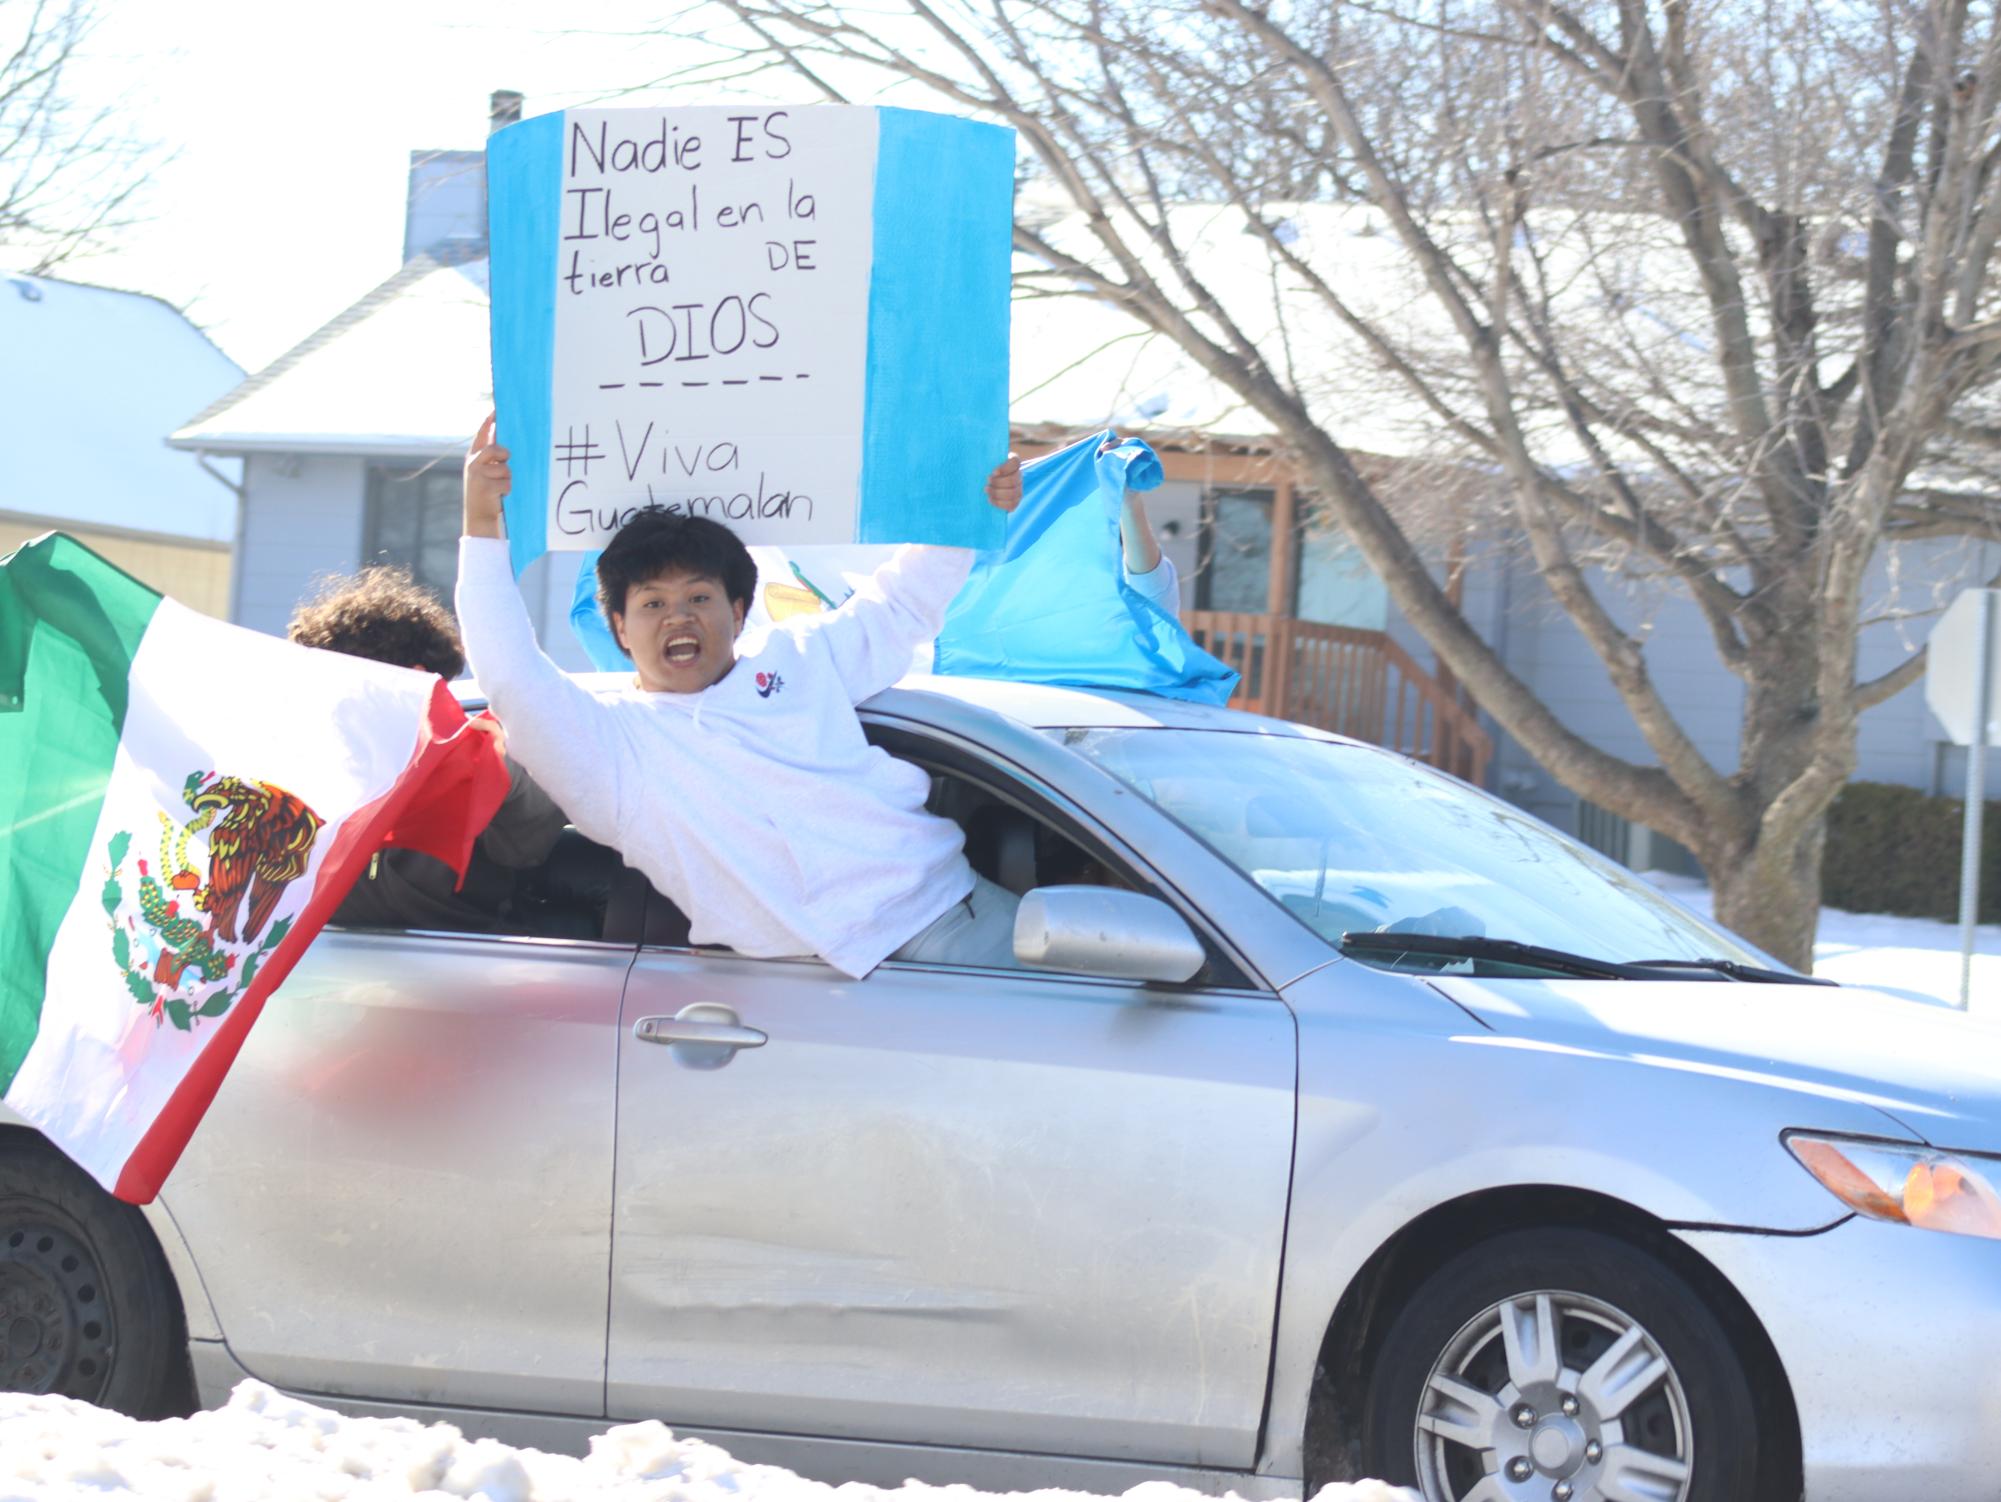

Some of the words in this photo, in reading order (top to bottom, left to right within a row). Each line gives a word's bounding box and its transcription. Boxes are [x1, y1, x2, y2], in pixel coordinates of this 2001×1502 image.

[571, 116, 702, 178] Nadie
[727, 111, 791, 162] ES
[564, 184, 697, 259] Ilegal
[716, 201, 764, 228] en
[788, 178, 816, 220] la
[564, 250, 670, 294] tierra
[766, 240, 817, 272] DE
[627, 293, 779, 366] DIOS
[555, 420, 739, 481] #Viva
[556, 472, 814, 536] Guatemalan
